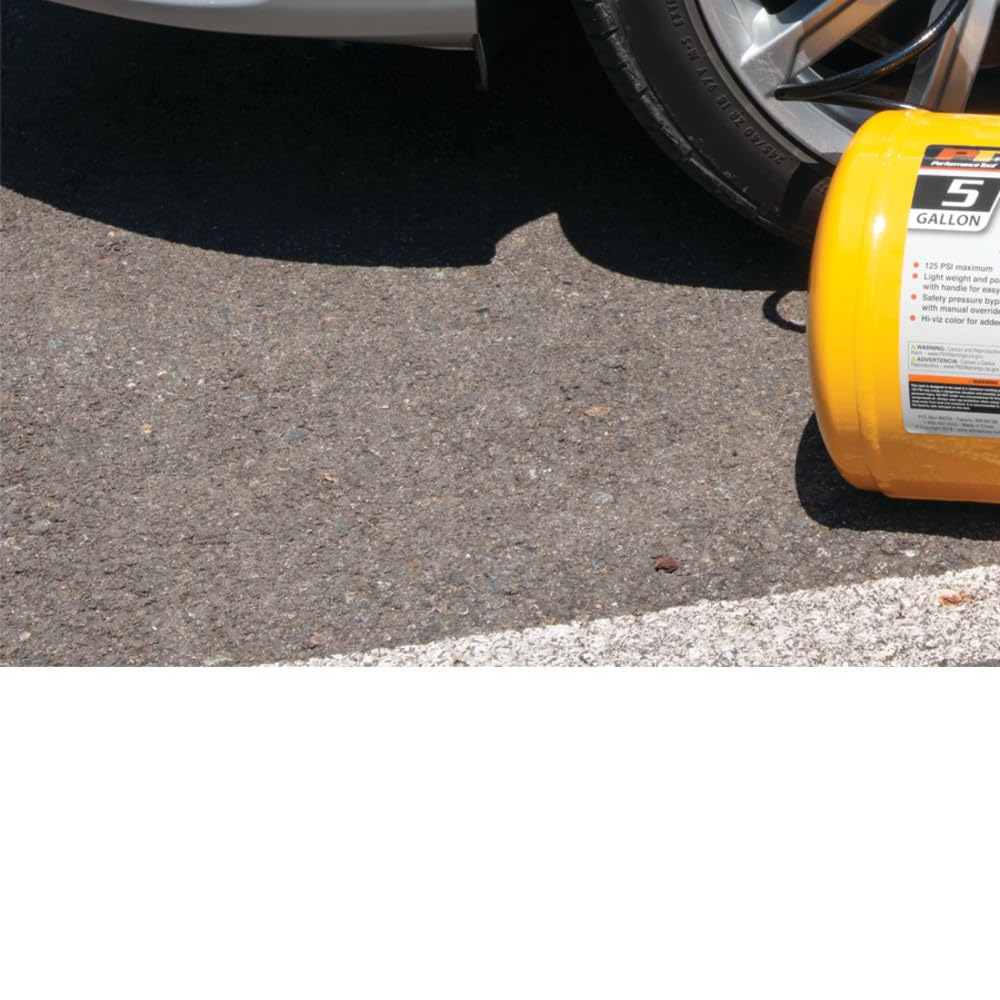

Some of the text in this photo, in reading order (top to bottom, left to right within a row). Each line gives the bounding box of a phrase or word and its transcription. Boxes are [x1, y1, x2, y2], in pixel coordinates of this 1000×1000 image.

[716, 94, 730, 112] 18
[728, 108, 745, 128] ZR
[941, 178, 984, 208] 5
[916, 212, 980, 227] GALLON
[925, 262, 993, 272] 125 PSI maximum
[924, 273, 944, 282] Light
[946, 274, 972, 284] weight
[973, 276, 988, 284] and
[941, 284, 968, 292] handle
[970, 284, 980, 292] for
[982, 287, 1000, 295] easy
[922, 294, 947, 303] Safety
[948, 296, 982, 304] pressure
[940, 305, 968, 314] manual
[922, 315, 942, 323] Hi-viz
[944, 316, 964, 324] color
[966, 317, 978, 326] for
